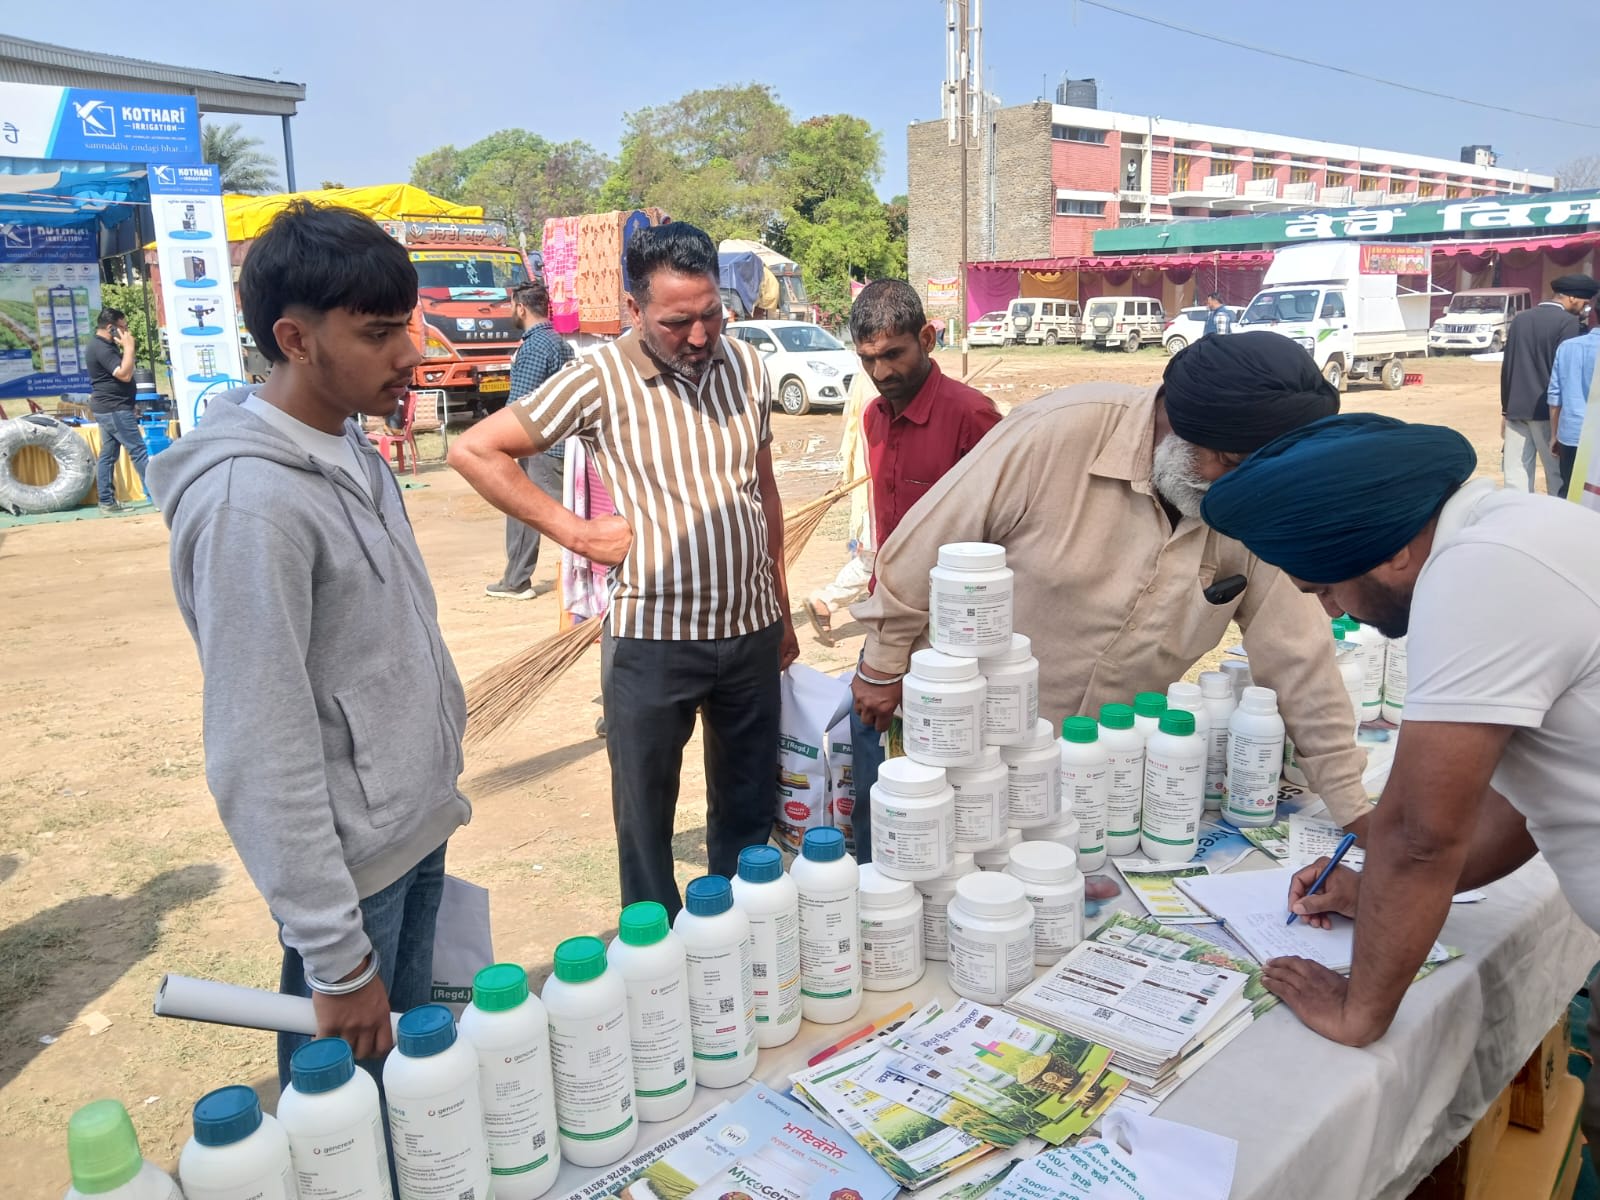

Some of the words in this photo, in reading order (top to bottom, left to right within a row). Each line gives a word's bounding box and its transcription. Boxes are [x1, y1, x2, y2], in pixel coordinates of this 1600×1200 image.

[132, 122, 177, 132] IRRIGATION
[466, 331, 509, 339] EICHER
[433, 989, 471, 1000] (Regd.)
[323, 1138, 355, 1154] gencrest
